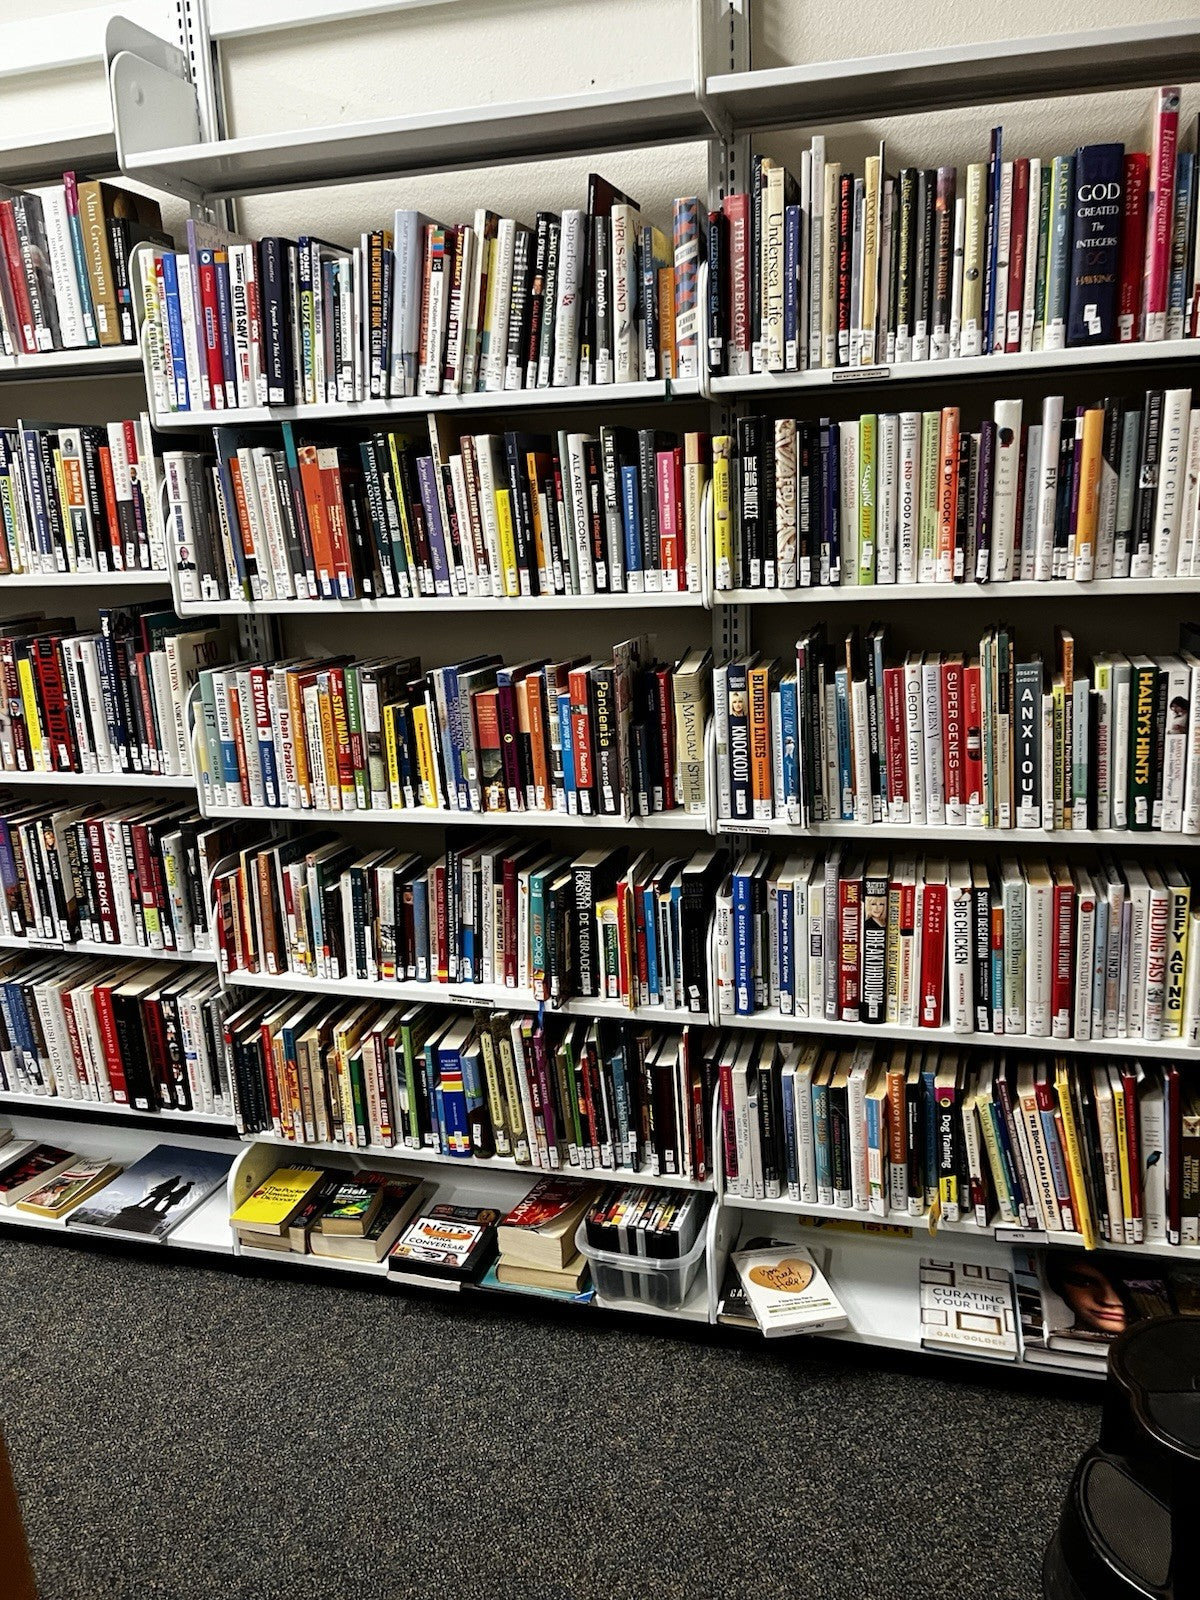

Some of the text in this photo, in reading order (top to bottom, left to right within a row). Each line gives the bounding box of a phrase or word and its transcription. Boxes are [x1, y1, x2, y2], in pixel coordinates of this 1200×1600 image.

[1058, 163, 1067, 210] PLASTIC
[1078, 182, 1120, 202] GOD
[1155, 129, 1175, 244] Heavenly Fragrance
[734, 218, 745, 252] THE
[900, 179, 912, 270] After Geoengineering
[1077, 206, 1119, 218] CREATED
[1092, 222, 1104, 232] The
[85, 190, 108, 296] Alan Greenspan
[455, 232, 464, 252] Jerry
[565, 218, 578, 291] SuperFoods
[826, 207, 838, 300] The Wild Chimpanzees
[1076, 238, 1117, 249] INTEGERS
[454, 254, 463, 286] Baker's
[544, 235, 558, 325] TWICE PARDONED
[597, 269, 606, 317] Provoke
[768, 213, 783, 326] Undersea Life
[234, 285, 248, 349] GOTTA SAY IT
[270, 305, 278, 326] Speak
[372, 235, 382, 355] AN INCONVENIENT BOOK GLENN
[450, 299, 460, 320] PAYS
[145, 284, 160, 371] INCLUSION REVOLUTION
[273, 358, 281, 378] Child
[27, 440, 35, 451] THE
[29, 453, 38, 479] PROMISE
[743, 456, 758, 472] THE
[1167, 427, 1180, 479] FIRST
[605, 436, 616, 506] THE NEXT WAVE
[744, 472, 758, 486] BIG
[904, 461, 913, 480] END
[905, 482, 911, 490] OF
[1045, 467, 1056, 490] FIX
[364, 471, 379, 523] IN COLLEGE
[367, 447, 389, 544] STUDENT DEVELOPMENT
[572, 454, 587, 551] ALL ARE WELCOME
[744, 487, 759, 520] SQUEEZE
[903, 491, 912, 519] FOOD
[941, 490, 952, 549] CLOCK DIET
[1162, 481, 1176, 521] CELL
[167, 644, 184, 728] TWO NATIONS ANDREW
[216, 682, 229, 737] THE BLUEPRINT
[252, 675, 267, 724] REVIVAL
[682, 691, 692, 700] A
[716, 678, 726, 717] WISHES
[204, 703, 215, 728] LIFT
[239, 680, 252, 745] SEAN HANNITY
[332, 695, 349, 745] STAY MAD
[460, 689, 473, 755] MLA Handbook
[597, 682, 611, 747] Pandemia
[683, 705, 697, 754] MANUAL
[752, 675, 766, 758] BLURRED LINES
[908, 681, 921, 766] Clean Lean
[946, 673, 958, 768] SUPER GENES
[1135, 673, 1153, 785] HALEY'S HINTS
[279, 713, 296, 783] Dean Graziosi
[577, 719, 589, 783] Ways of Reading
[732, 726, 749, 782] KNOCKOUT
[1021, 688, 1034, 792] ANXIOU
[1055, 758, 1062, 766] TO
[688, 765, 702, 801] STYLE
[89, 825, 110, 915] GLENN BECK BROKE
[842, 885, 859, 965] SHAPE ULTIMATE BODY
[954, 901, 971, 965] BIG CHICKEN
[977, 892, 988, 958] SWEET DECEPTION
[1011, 904, 1022, 947] Tell-Tale
[1149, 899, 1166, 984] HOLDING FAST
[1011, 948, 1022, 975] Brain
[1081, 915, 1089, 986] THE CHINA STUDY
[1168, 895, 1187, 1010] DEFY AGING
[40, 999, 63, 1078] THE BUSH AGEND
[98, 992, 115, 1054] BOB WOODWARD
[532, 1083, 540, 1108] ENLACES
[892, 1079, 900, 1127] UNSAVORY
[940, 1115, 952, 1168] Dog Training
[1029, 1115, 1038, 1129] THE
[1030, 1129, 1042, 1155] ROGER
[338, 1186, 367, 1195] Irish
[1035, 1156, 1048, 1180] CARAS
[1039, 1182, 1052, 1199] DOG
[408, 1237, 464, 1251] CONVERSAR
[932, 1288, 1006, 1304] CURATING
[934, 1298, 1000, 1312] YOUR LIFE
[936, 1330, 960, 1340] GAIL
